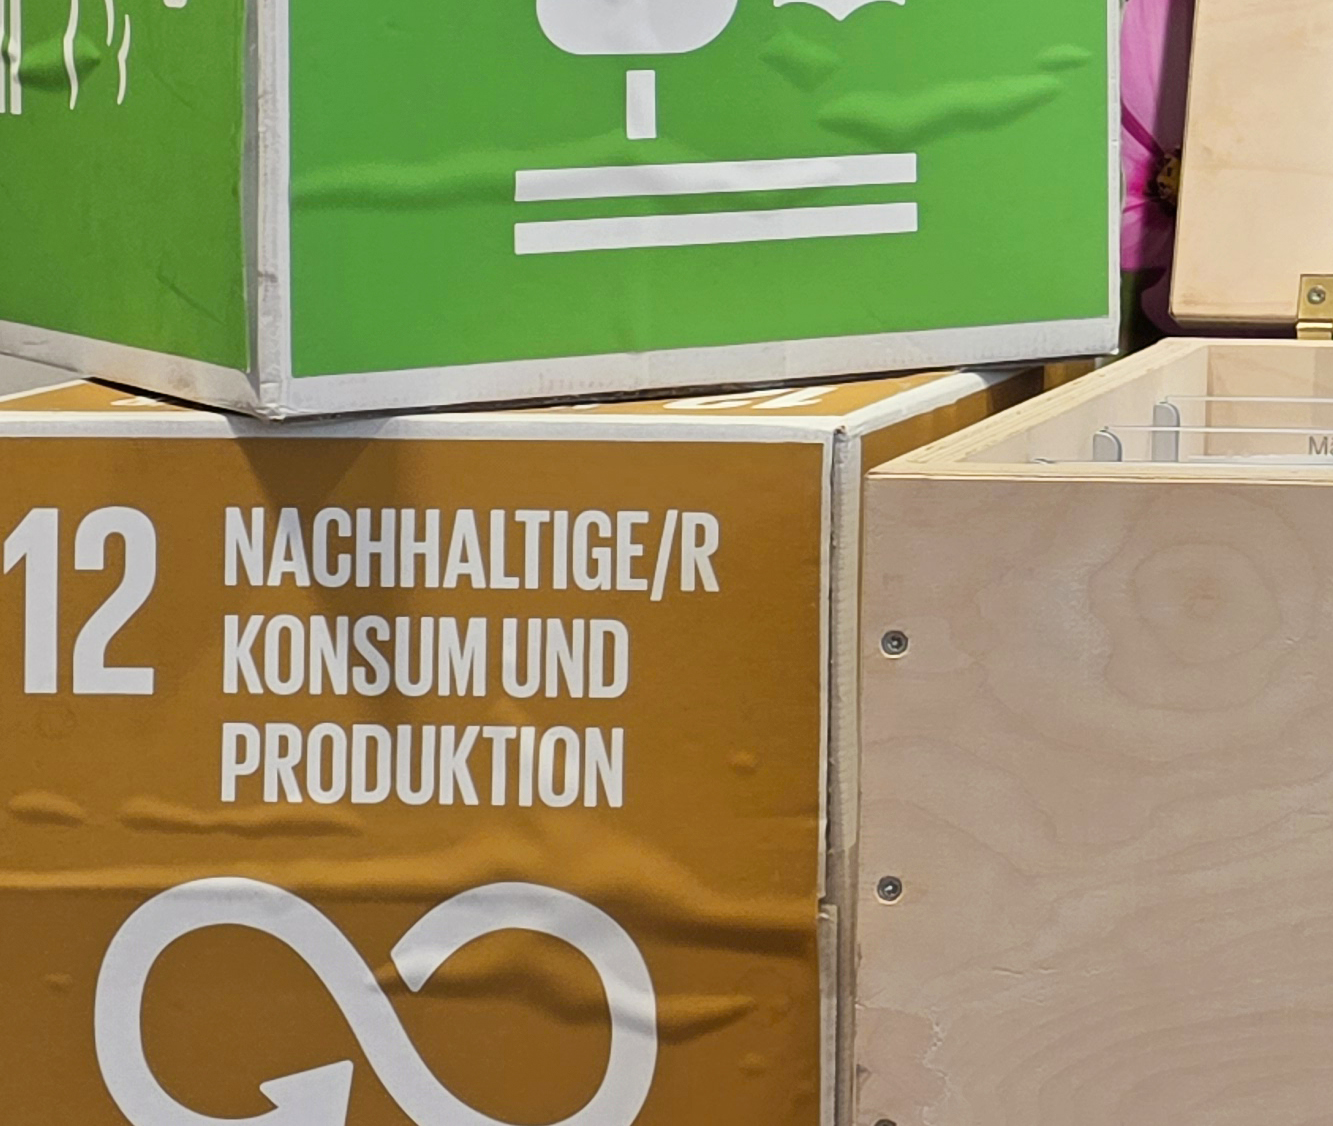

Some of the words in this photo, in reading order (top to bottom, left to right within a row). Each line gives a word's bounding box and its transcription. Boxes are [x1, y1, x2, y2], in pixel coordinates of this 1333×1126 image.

[224, 506, 720, 602] NACHHALTIGE/R
[2, 505, 157, 696] 12
[222, 615, 487, 698] KONSUM
[501, 617, 629, 699] UND
[220, 722, 624, 808] PRODUKTION
